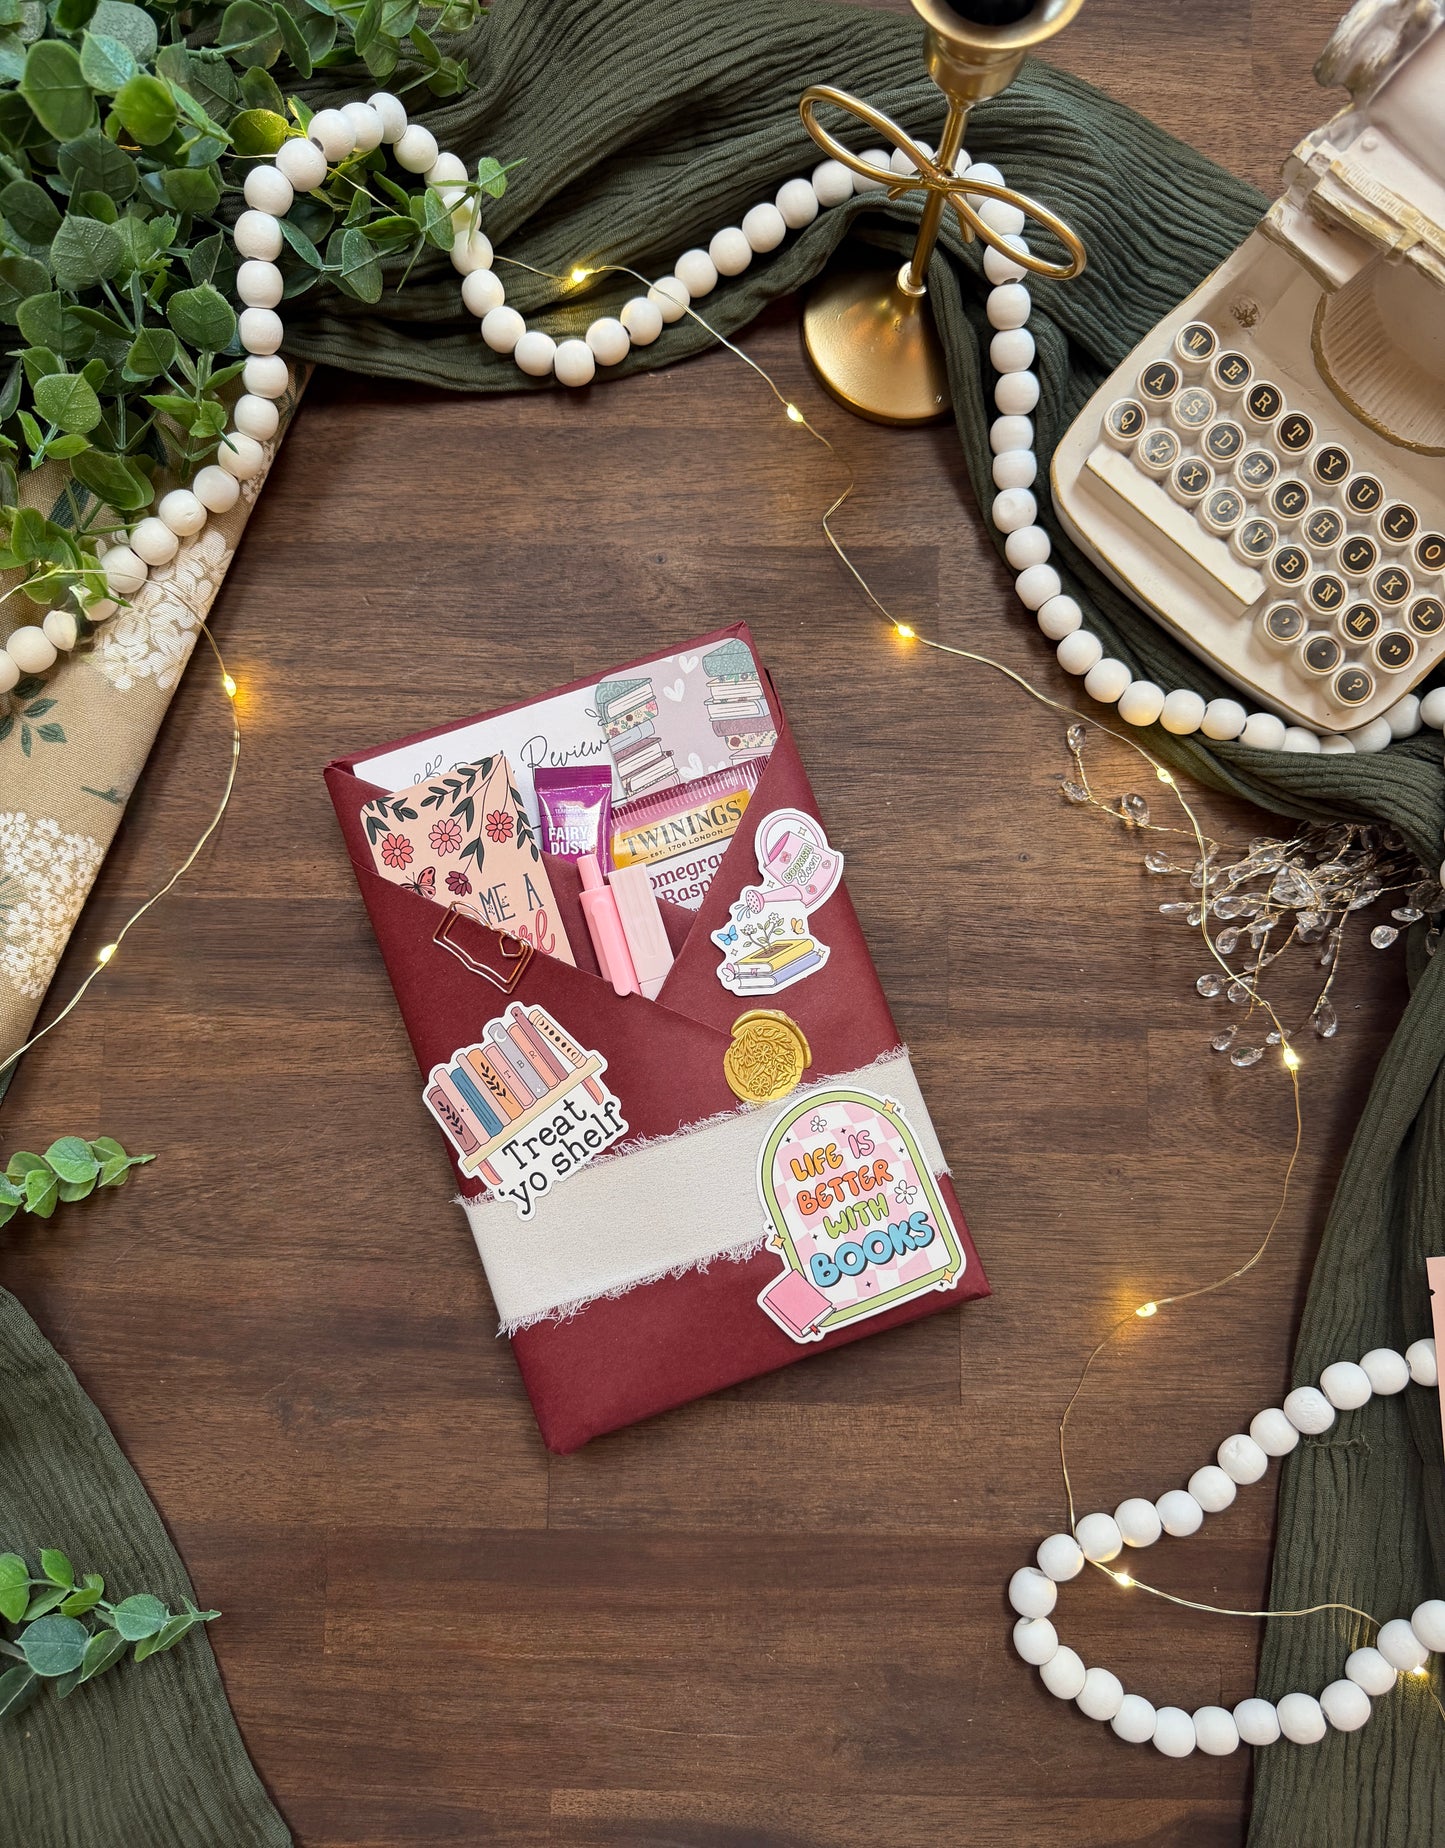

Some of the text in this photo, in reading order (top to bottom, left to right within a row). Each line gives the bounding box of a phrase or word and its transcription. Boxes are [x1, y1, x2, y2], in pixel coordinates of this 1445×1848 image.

[1188, 331, 1441, 560] W E R T Y U I O
[1120, 409, 1136, 431] Q
[1152, 441, 1170, 458] Z
[1182, 466, 1203, 486] X
[1216, 499, 1234, 516] C
[1251, 527, 1269, 545] V
[1280, 554, 1300, 574] B
[1317, 583, 1338, 602] N
[1351, 611, 1372, 632] M
[1149, 372, 1435, 626] A S D F G H J K L
[1347, 678, 1363, 691] ?
[520, 735, 609, 769] Review
[548, 826, 589, 841] FAIRY
[550, 840, 588, 856] DUST
[622, 800, 742, 857] TWININGS
[650, 828, 724, 858] EST. 1706 LONDON
[478, 873, 545, 926] ME A
[502, 1099, 588, 1170] Treat
[551, 1100, 624, 1176] shelf
[790, 1130, 875, 1182] LIFE IS
[797, 1159, 894, 1216] BETTER
[823, 1193, 890, 1240] WITH
[809, 1211, 936, 1288] BOOKS
